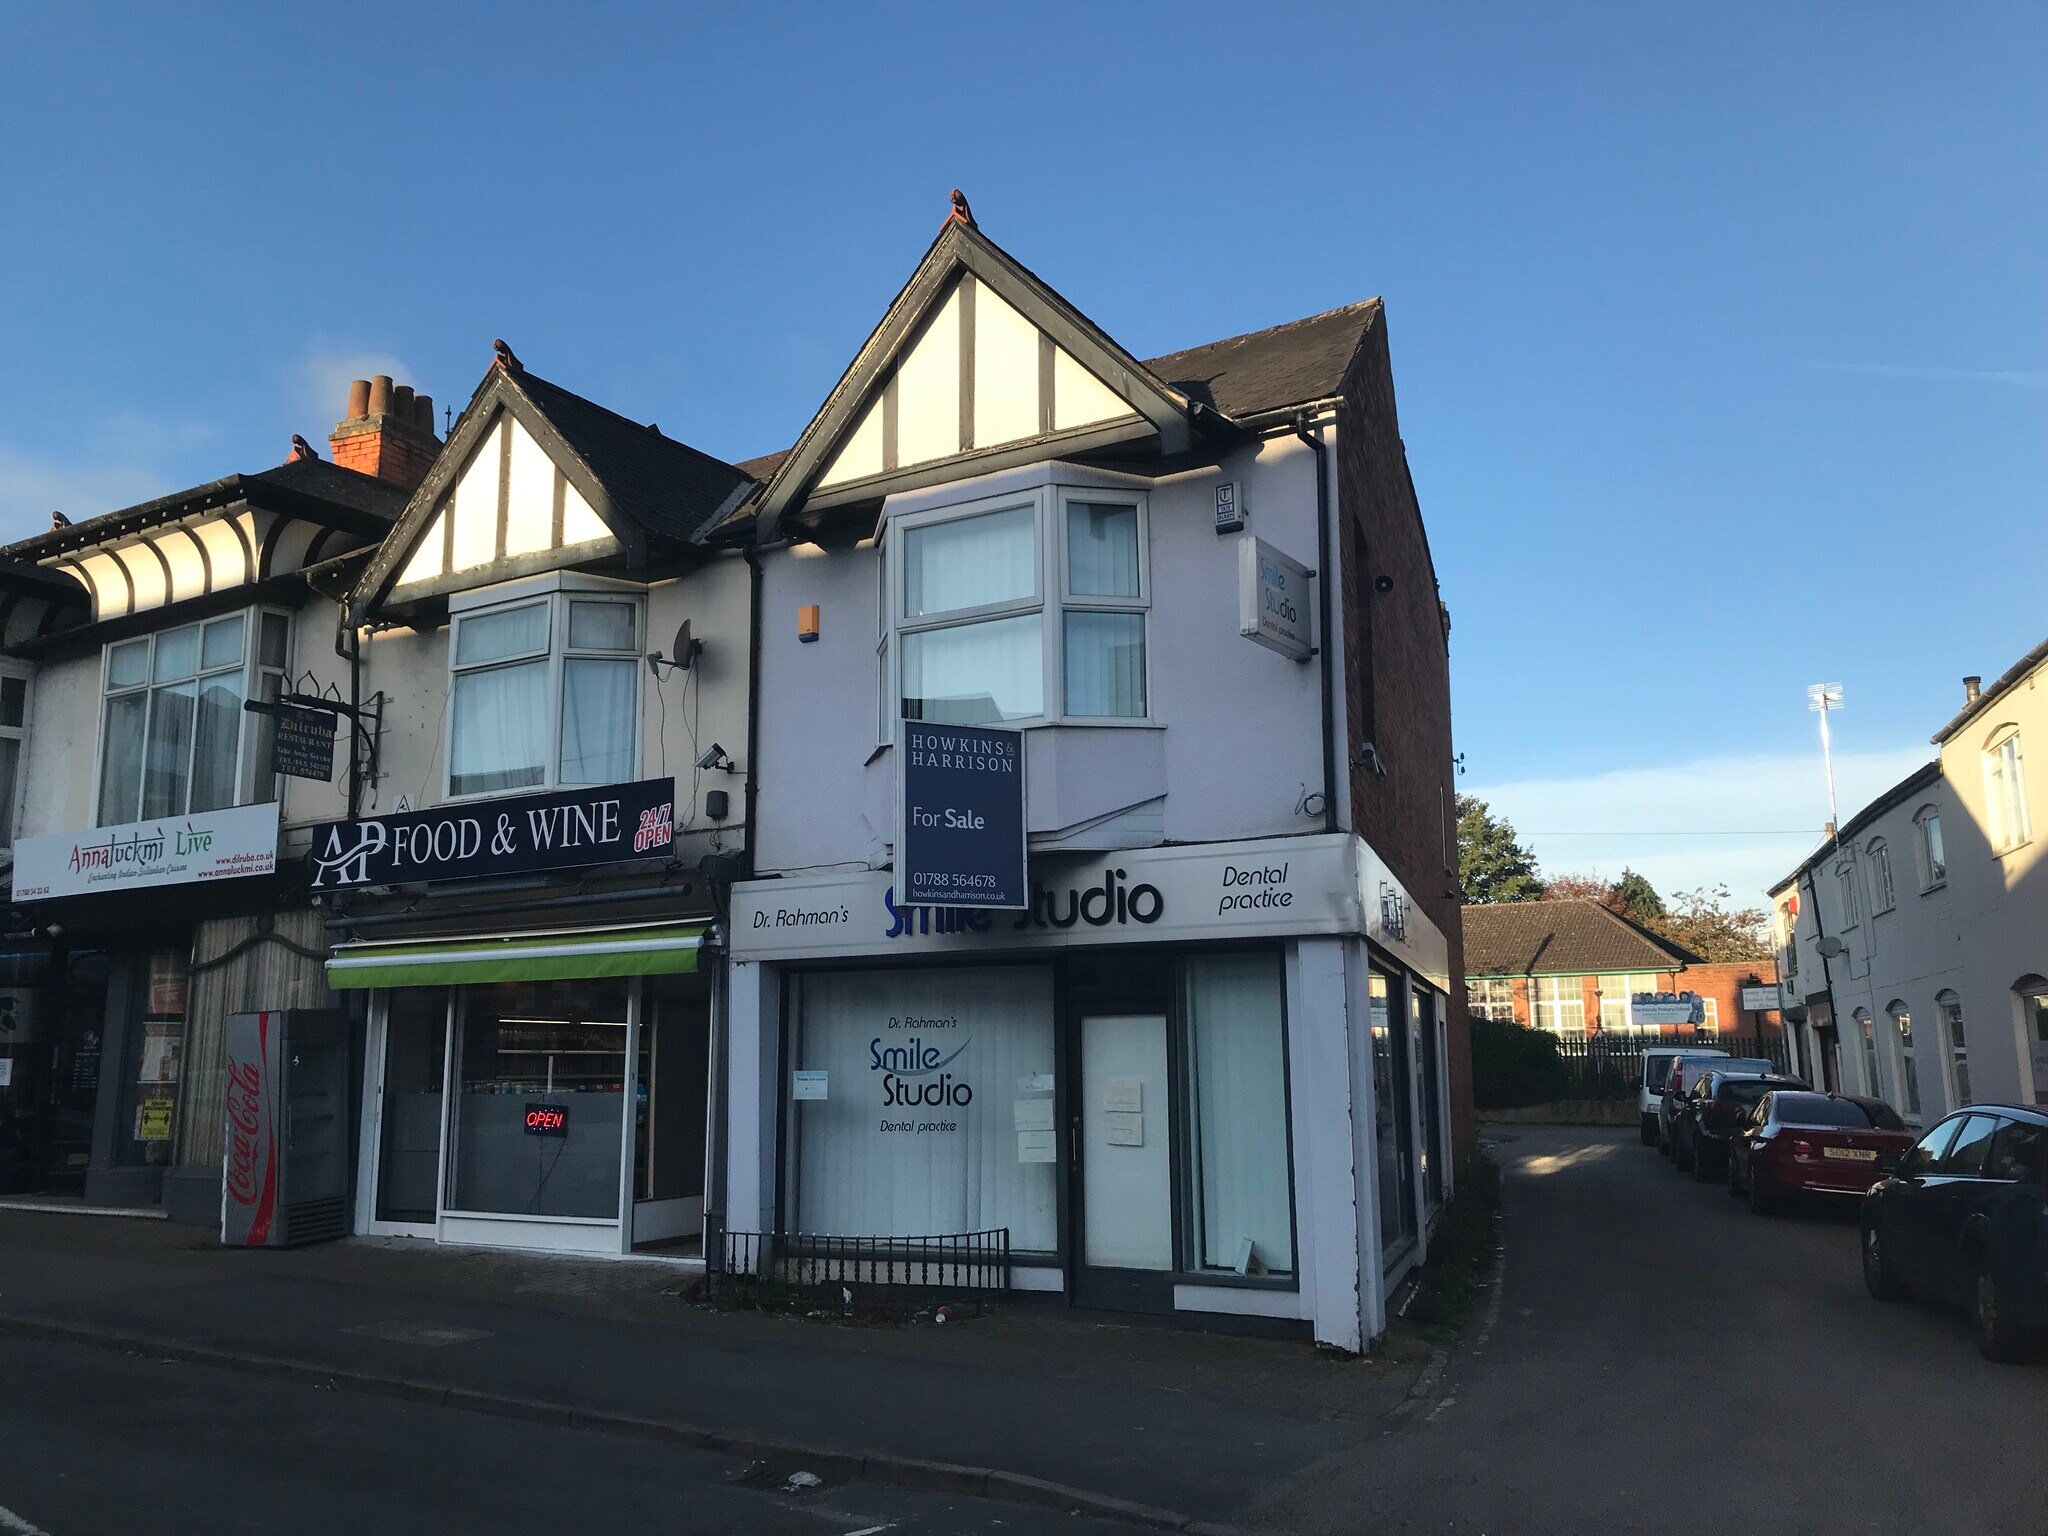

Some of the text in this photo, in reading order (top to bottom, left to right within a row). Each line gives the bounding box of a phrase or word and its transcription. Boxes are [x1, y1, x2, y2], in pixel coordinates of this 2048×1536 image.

[1260, 557, 1285, 591] Smile
[1265, 588, 1297, 624] Studio
[281, 717, 333, 738] Dilruba
[278, 732, 332, 749] RESTAURANT
[309, 752, 331, 763] Service
[912, 752, 1013, 773] HARRISON
[637, 802, 672, 831] 24/7
[913, 806, 985, 830] For Sale
[175, 821, 215, 857] Live
[310, 799, 622, 887] AP FOOD & WINE
[633, 821, 673, 854] OPEN
[166, 864, 188, 876] Cuisine
[198, 862, 274, 878] www.annaluckmi.co.uk
[913, 872, 996, 888] 01788 564678
[1222, 862, 1288, 888] Dental
[912, 889, 1006, 901] howkinsandharrison.co.uk
[1218, 887, 1293, 917] practice
[752, 904, 849, 930] Dr. Rahman's
[888, 1016, 957, 1029] Dr. Rahman's
[870, 1037, 941, 1071] Smile
[882, 1073, 973, 1107] Studio
[526, 1112, 564, 1128] OPEN
[880, 1120, 957, 1135] Dental practice
